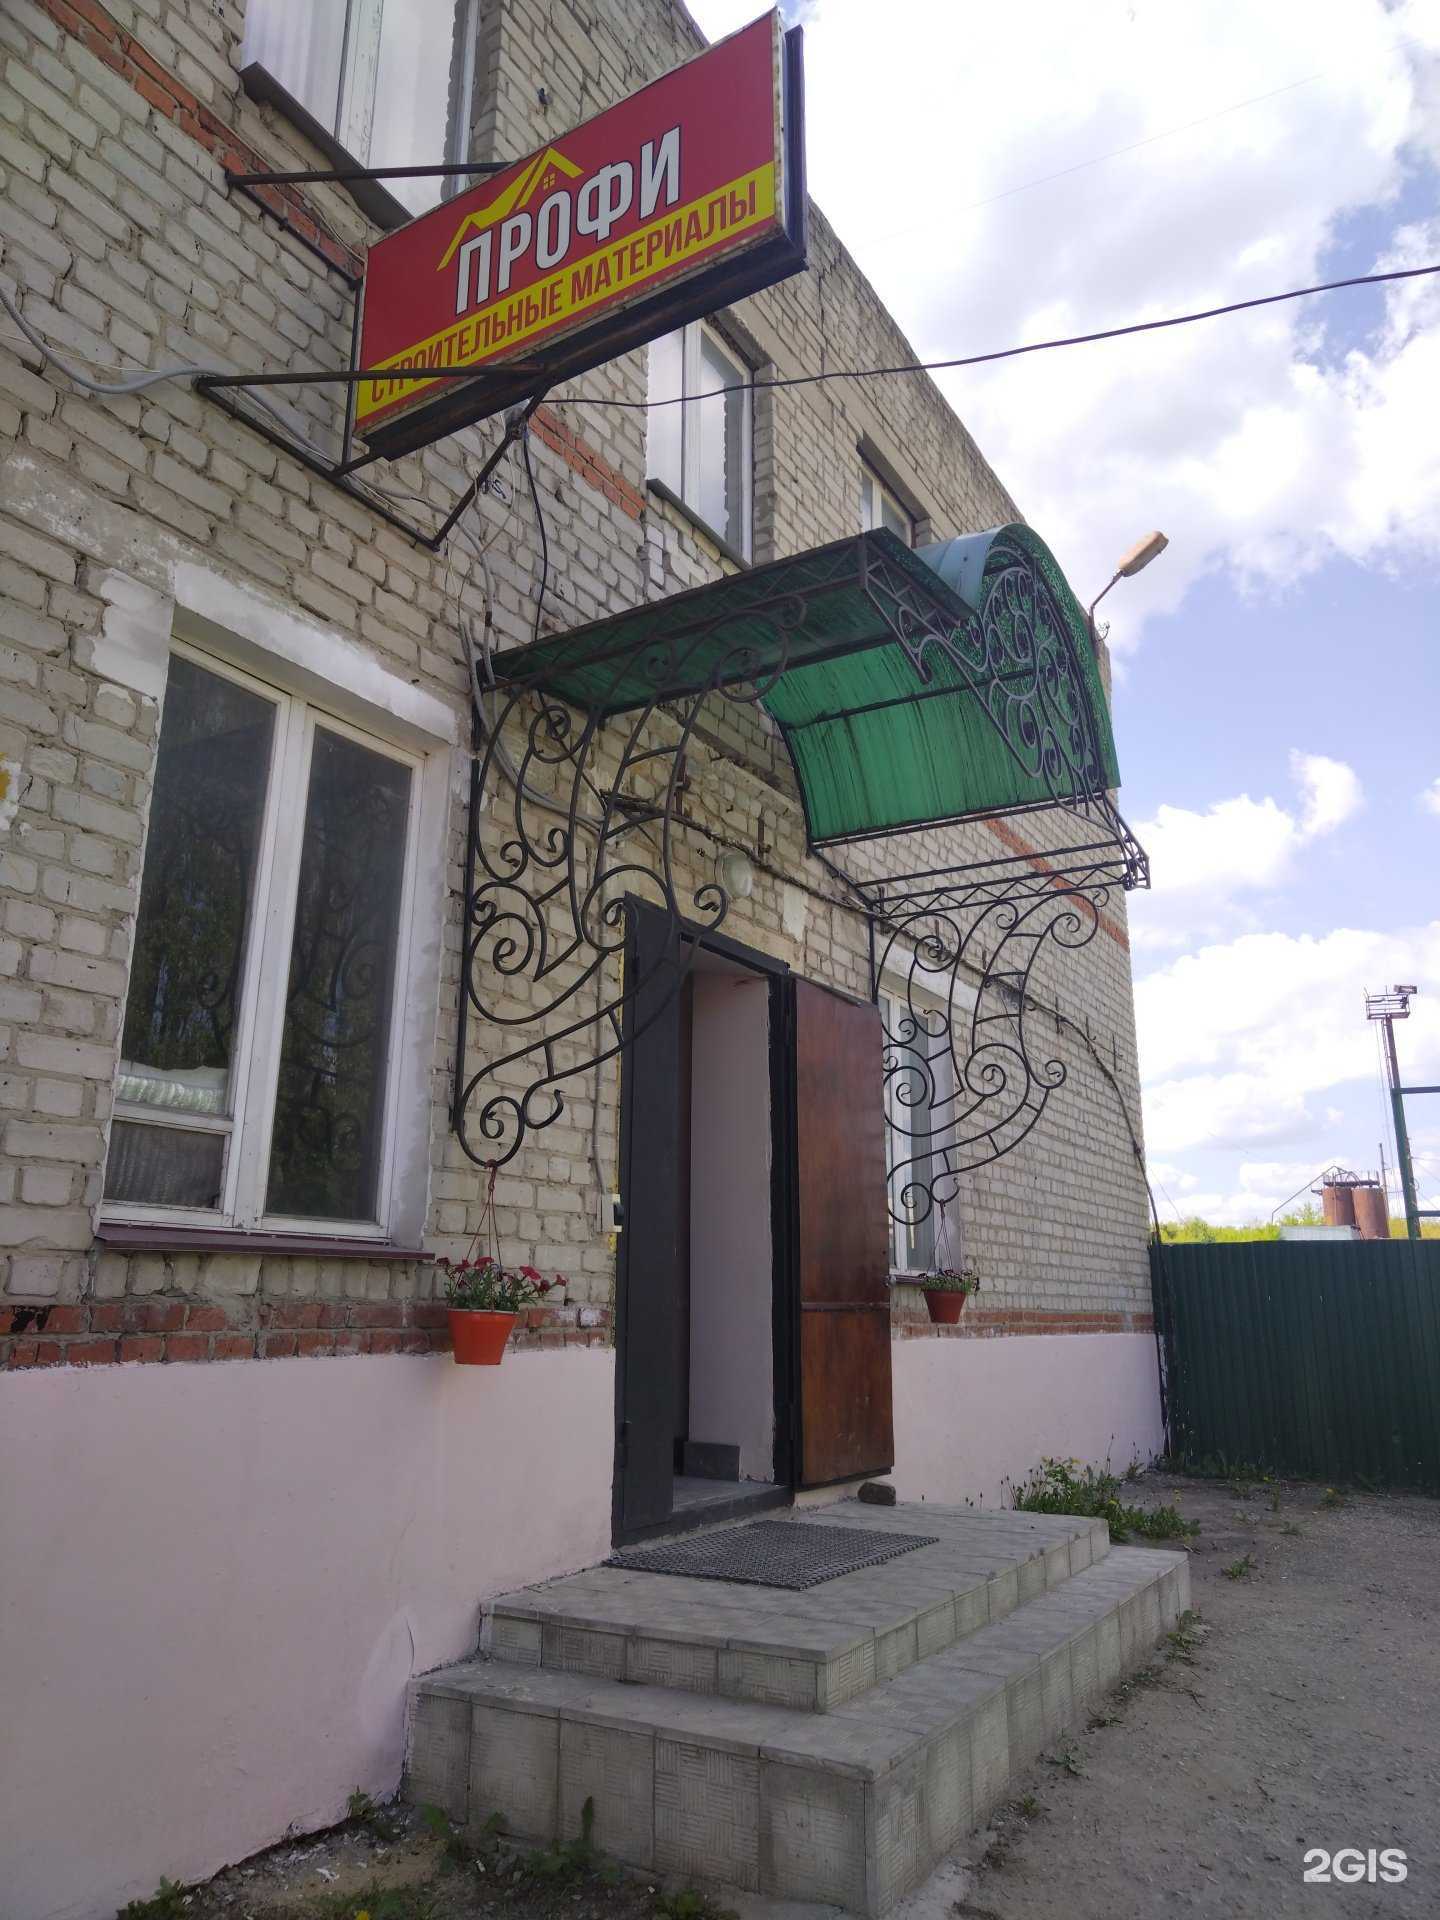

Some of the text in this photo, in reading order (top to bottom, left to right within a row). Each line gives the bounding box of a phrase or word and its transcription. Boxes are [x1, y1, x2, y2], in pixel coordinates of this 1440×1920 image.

[371, 180, 756, 402] СТРОИТЕЛЬНЫЕ МАТЕРИАЛЫ
[455, 125, 682, 315] ПРОФИ
